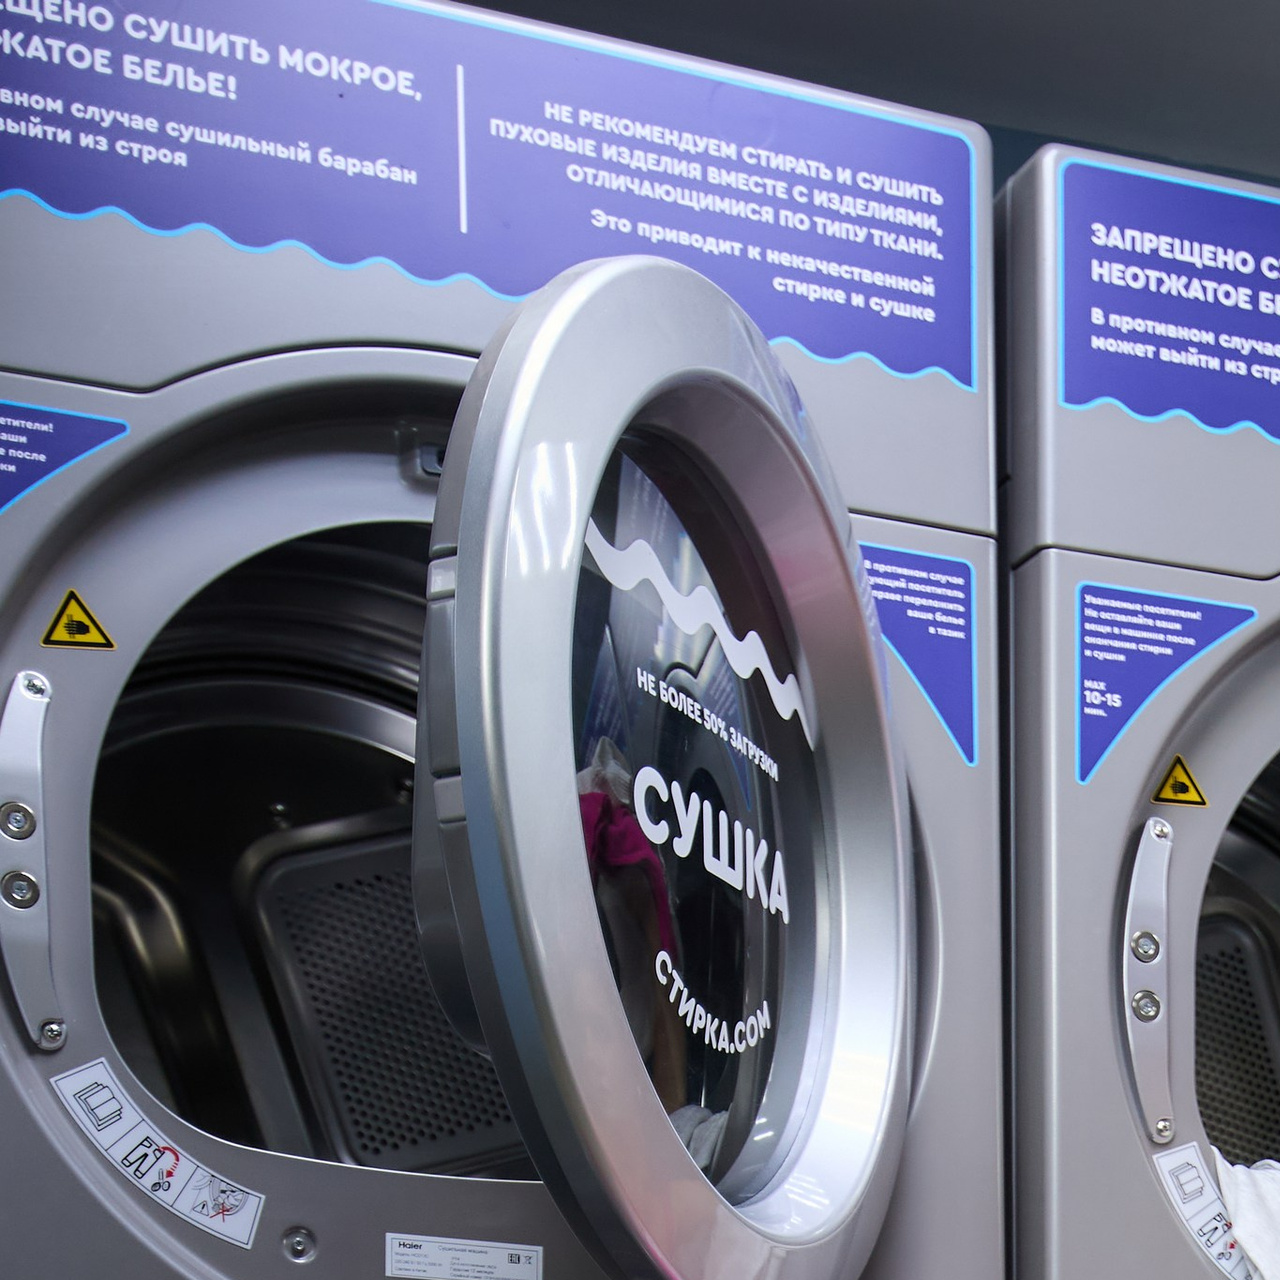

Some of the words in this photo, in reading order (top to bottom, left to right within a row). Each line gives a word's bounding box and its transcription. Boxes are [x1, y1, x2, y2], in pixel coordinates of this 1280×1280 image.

[0, 0, 114, 31] ЩЕНО
[125, 14, 270, 64] СУШИТЬ
[279, 45, 421, 101] МОКРОЕ,
[0, 30, 112, 74] КАТОЕ
[124, 55, 236, 100] БЕЛЬЕ!
[71, 103, 159, 132] случае
[166, 122, 311, 163] сушильный
[319, 147, 417, 184] барабан
[490, 119, 596, 157] ПУХОВЫЕ
[602, 143, 701, 180] ИЗДЕЛИЯ
[707, 166, 788, 199] ВМЕСТЕ
[792, 186, 808, 203] С
[813, 189, 943, 236] ИЗДЕЛИЯМИ,
[545, 102, 573, 123] НЕ
[579, 109, 737, 160] РЕКОМЕНДУЕМ
[742, 147, 832, 180] СТИРАТЬ
[837, 167, 852, 185] И
[856, 172, 943, 205] СУШИТЬ
[567, 164, 774, 223] ОТЛИЧАЮЩИМИСЯ
[780, 210, 810, 230] ПО
[813, 217, 874, 242] ТИПУ
[871, 229, 943, 260] ТКАНИ.
[1091, 223, 1255, 274] ЗАПРЕЩЕНО
[1092, 259, 1252, 310] НЕОТЖАТОЕ
[1091, 307, 1105, 325] В
[1109, 314, 1215, 345] противном
[637, 667, 657, 697] НЕ
[659, 680, 702, 725] БОЛЕЕ
[703, 708, 728, 742] 50%
[729, 726, 779, 782] ЗАГРУЗКИ
[1084, 690, 1122, 707] 10-15
[633, 766, 790, 924] СУШКА
[398, 1242, 422, 1250] Haier
